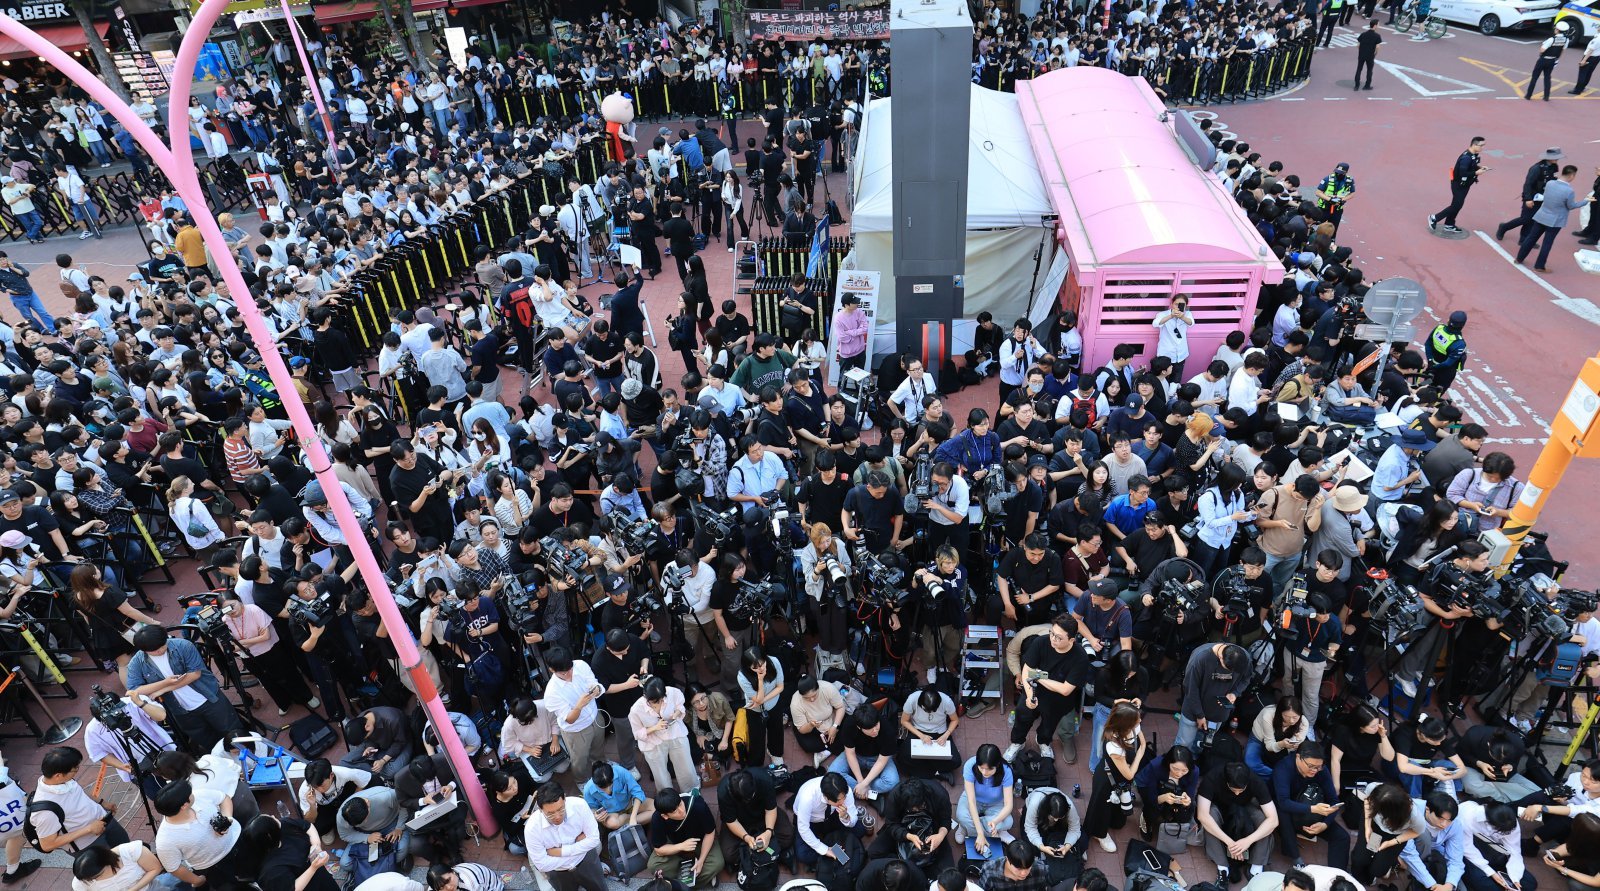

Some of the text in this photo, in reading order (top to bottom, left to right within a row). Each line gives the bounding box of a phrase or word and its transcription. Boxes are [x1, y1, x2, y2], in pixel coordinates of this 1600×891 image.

[795, 13, 835, 24] 파괴하는
[838, 11, 859, 23] 역사
[863, 9, 883, 21] 추진
